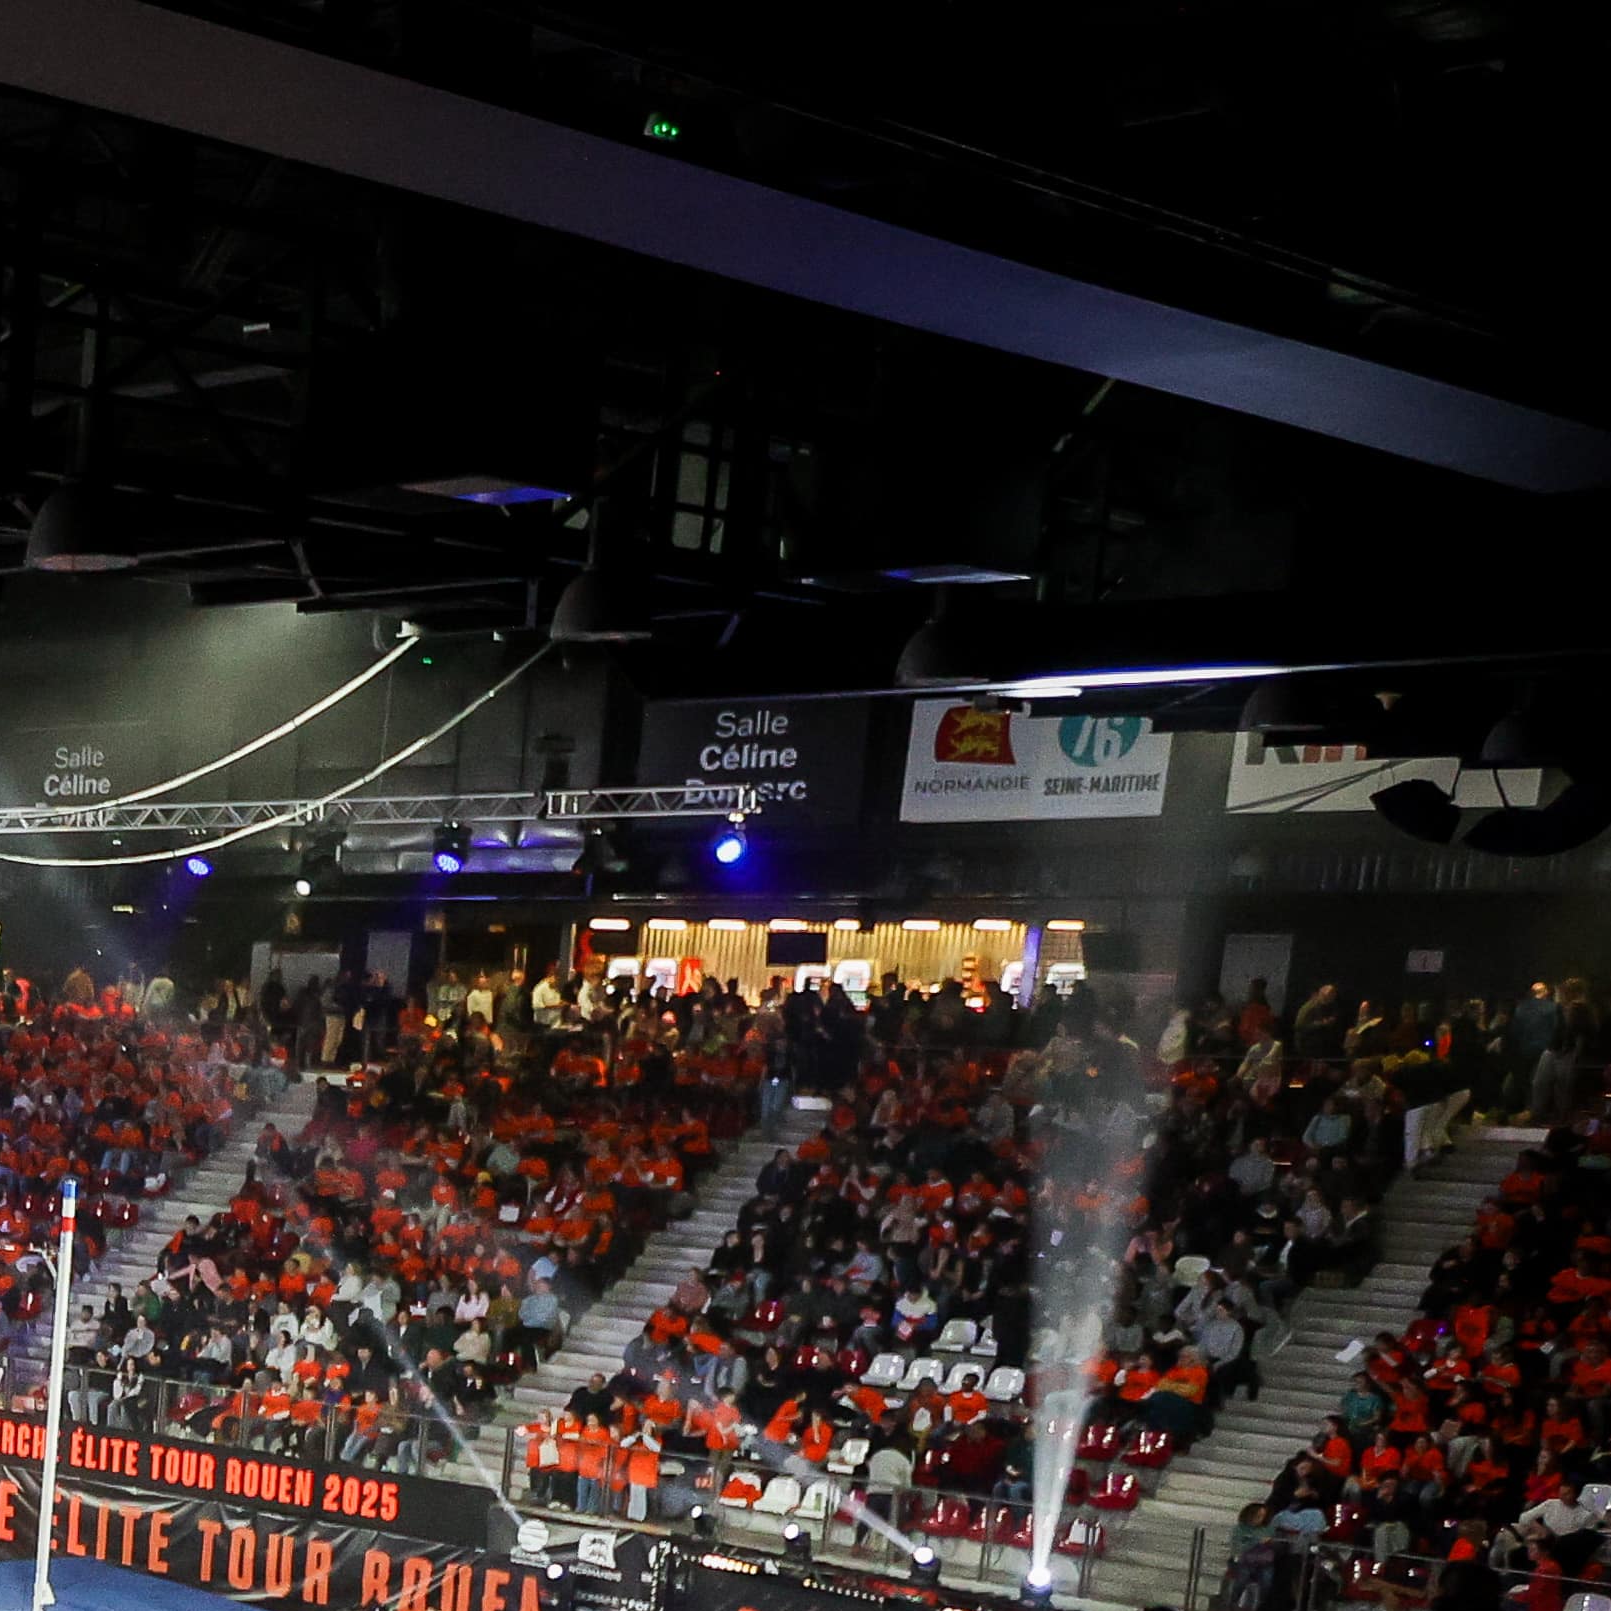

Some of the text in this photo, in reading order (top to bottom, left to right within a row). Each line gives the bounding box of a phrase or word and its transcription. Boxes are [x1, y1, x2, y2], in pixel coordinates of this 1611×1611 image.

[716, 711, 788, 738] Salle
[55, 745, 103, 770] Salle
[699, 744, 798, 771] Céline
[44, 773, 110, 797] Céline
[913, 776, 1030, 795] NORMANDIE
[1044, 772, 1161, 796] SEINE-MARITIME
[69, 1426, 141, 1477] ÉLITE
[150, 1443, 216, 1490] TOUR
[224, 1457, 315, 1508] ROUEN
[323, 1472, 399, 1522] 2025
[50, 1490, 173, 1576] LITE
[198, 1518, 334, 1606] TOUR
